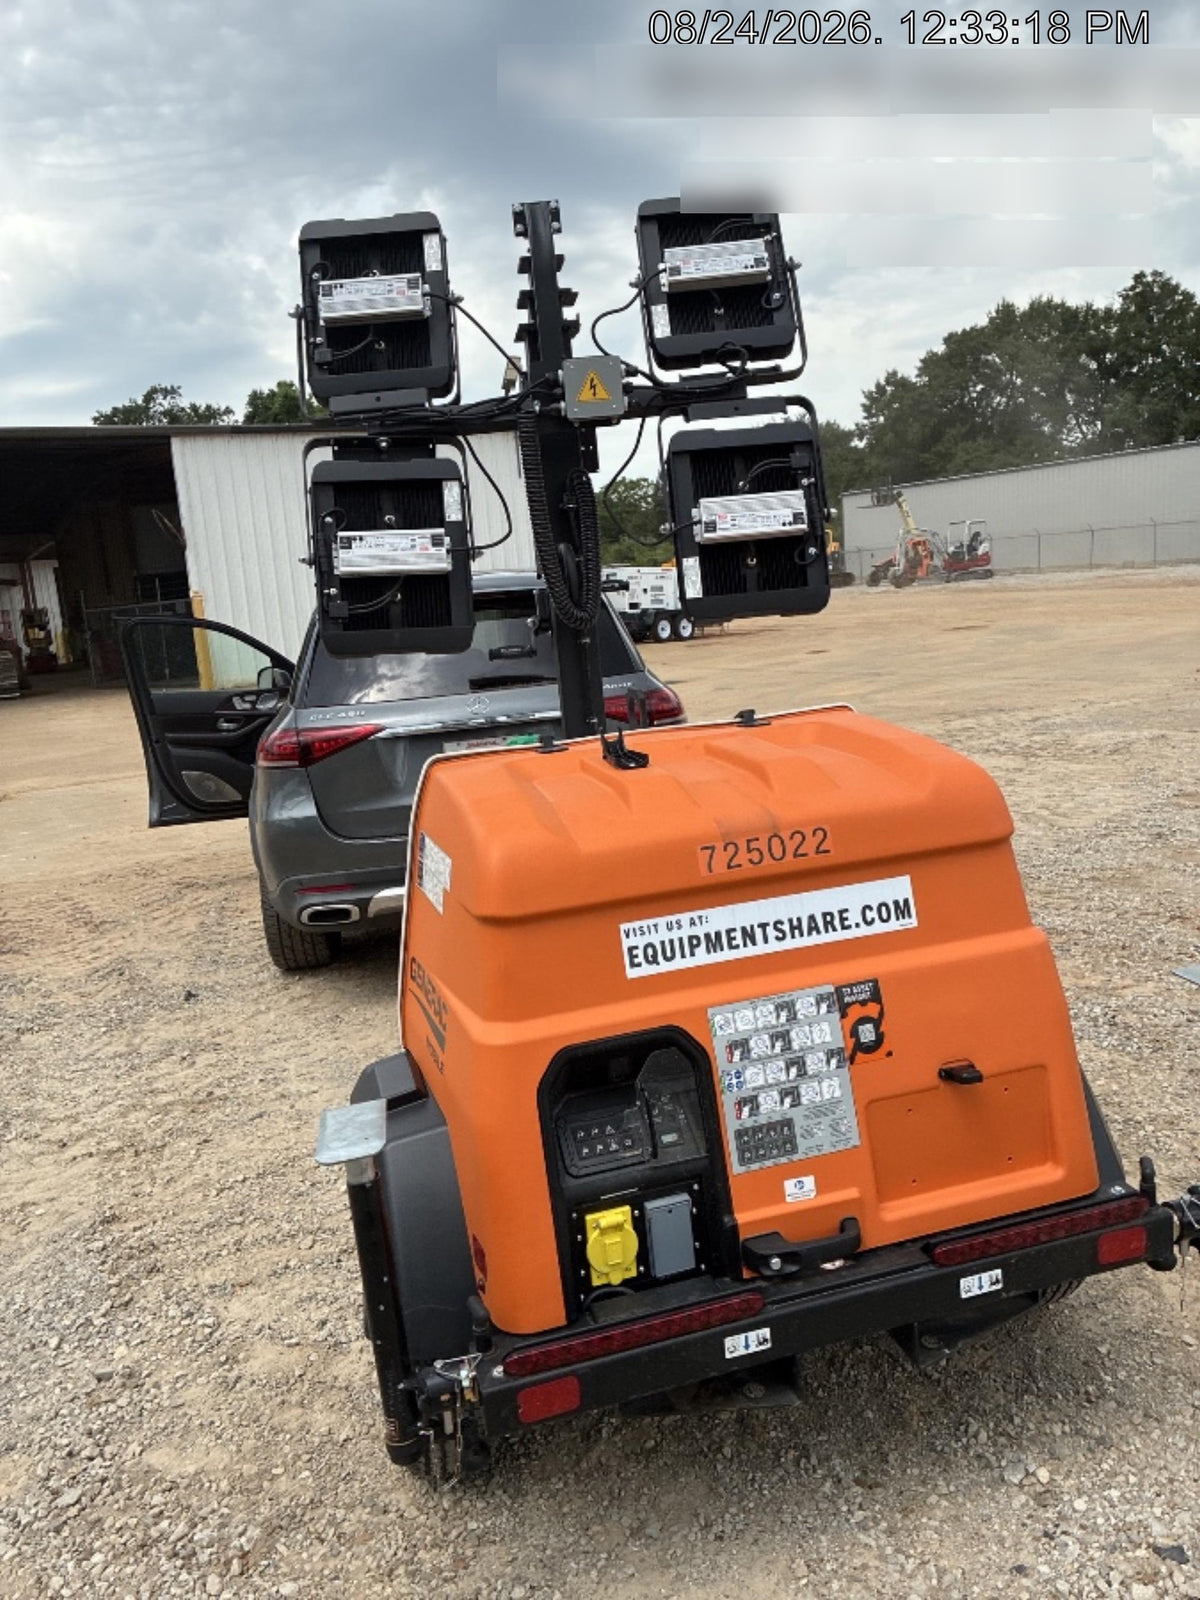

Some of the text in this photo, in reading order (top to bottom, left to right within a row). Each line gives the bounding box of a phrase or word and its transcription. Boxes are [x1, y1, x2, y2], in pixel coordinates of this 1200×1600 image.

[701, 827, 831, 874] 725022
[623, 915, 710, 939] VISIT US AT:
[627, 897, 912, 968] EQUIPMENTSHARE.COM
